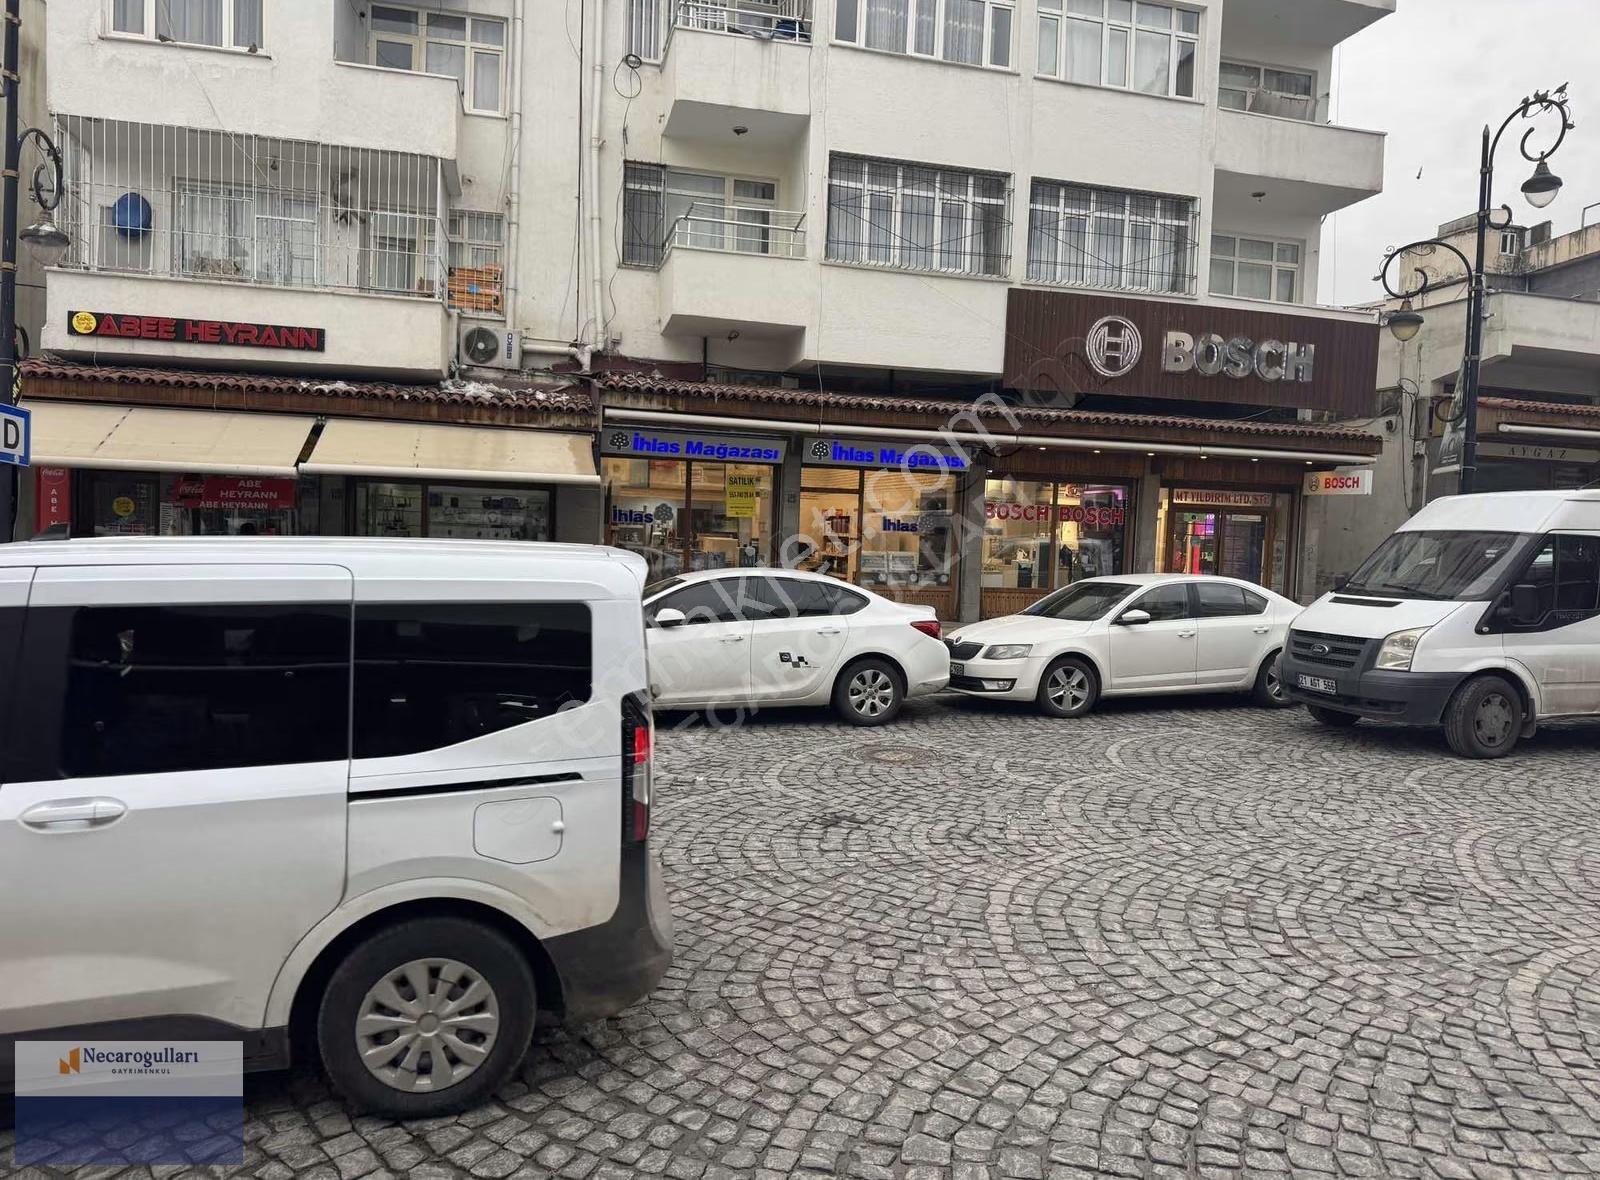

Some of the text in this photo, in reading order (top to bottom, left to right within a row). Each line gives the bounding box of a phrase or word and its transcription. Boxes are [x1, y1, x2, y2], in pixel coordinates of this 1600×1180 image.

[97, 314, 176, 340] ABEE
[185, 320, 318, 349] HEYRANN
[1161, 330, 1315, 383] BOSCH
[632, 433, 779, 461] İhlas Mağazası
[831, 441, 965, 469] İhlas Mağazası
[1509, 446, 1568, 460] AYGAZ
[238, 480, 262, 488] ABE
[1324, 476, 1360, 491] BOSCH
[219, 490, 278, 499] HEYRANN
[200, 501, 218, 509] ABE
[984, 502, 1052, 522] BOSCH
[612, 506, 654, 524] İhlas
[1059, 504, 1124, 526] BOSCH
